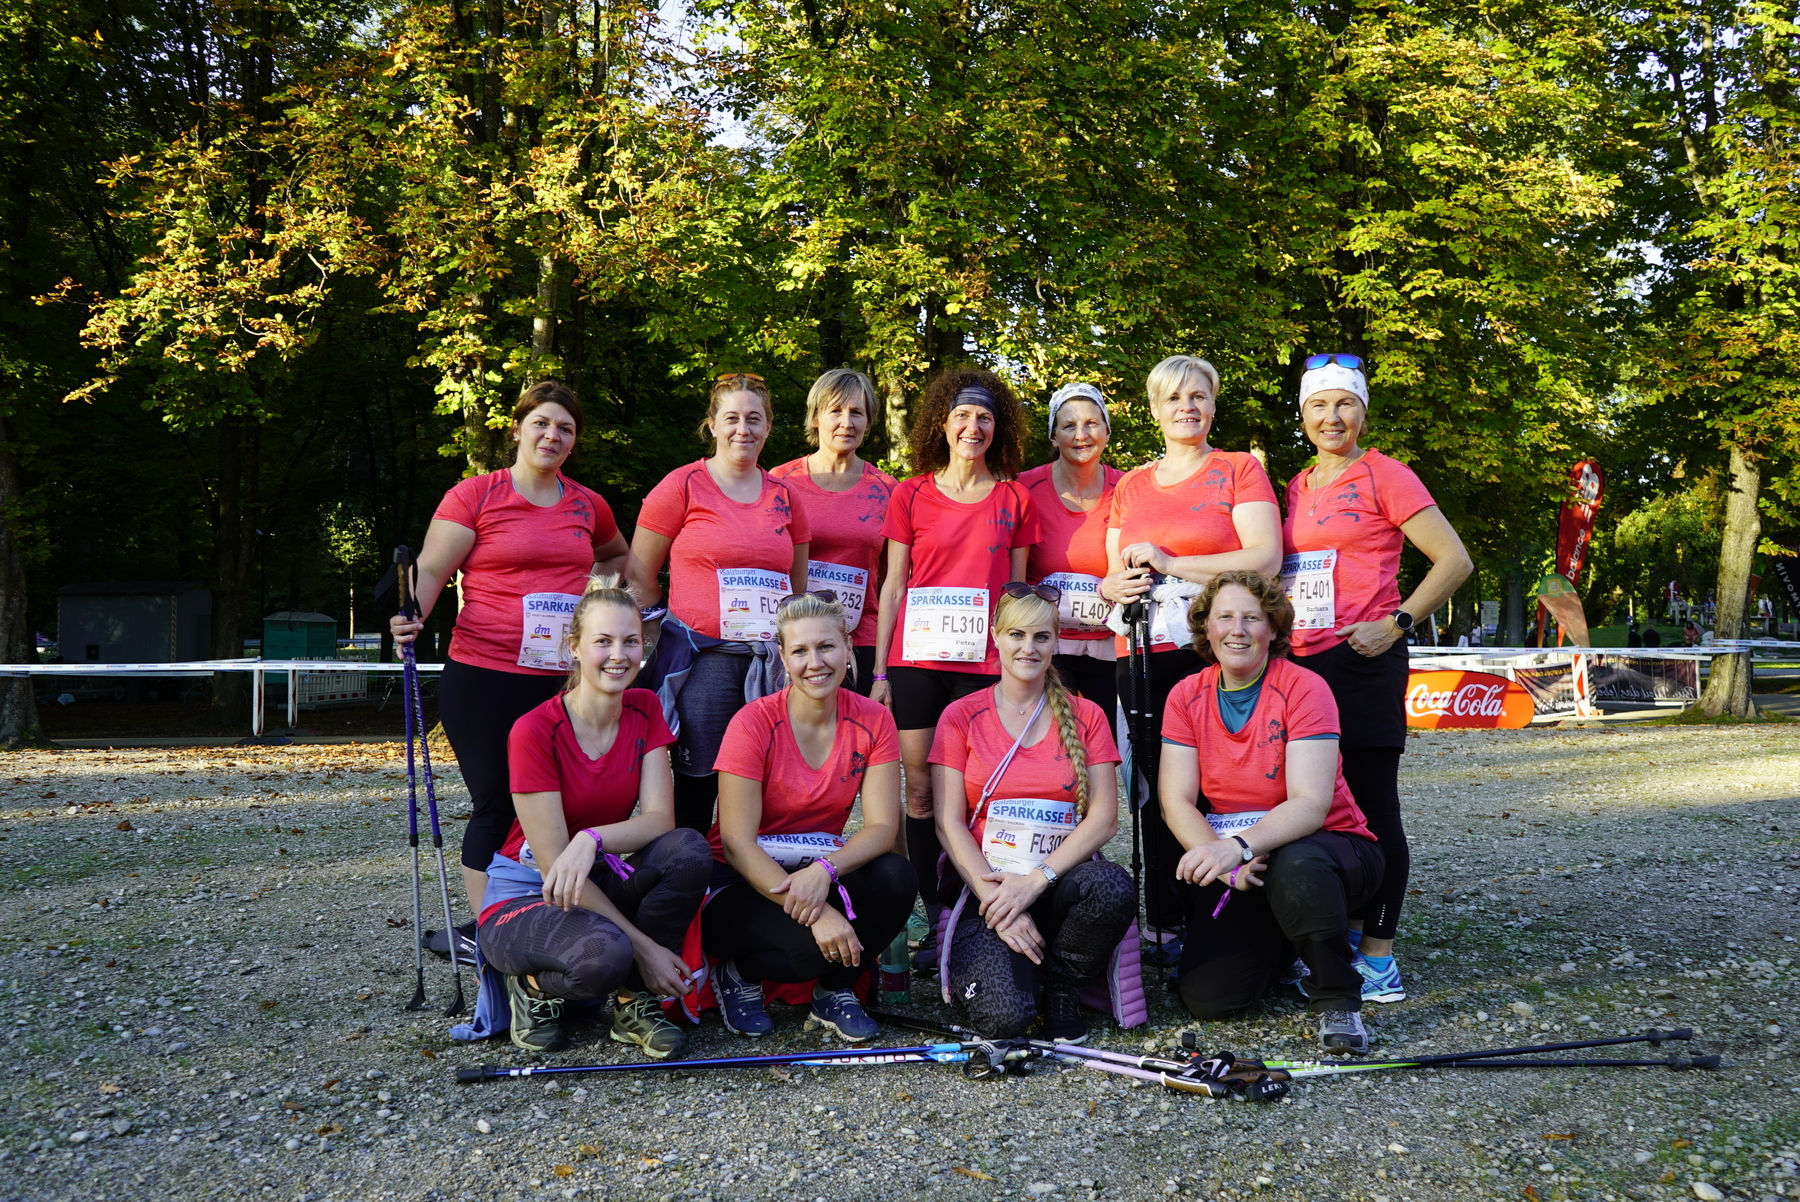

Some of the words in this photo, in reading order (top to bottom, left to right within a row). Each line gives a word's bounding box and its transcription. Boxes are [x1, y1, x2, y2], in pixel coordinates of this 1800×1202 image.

[1566, 528, 1586, 581] balance
[1283, 560, 1322, 574] SPARKASSE
[723, 576, 779, 590] SPARKASSE
[1300, 580, 1330, 600] FL401
[731, 597, 748, 607] dm
[911, 595, 971, 606] SPARKASSE
[1071, 600, 1112, 620] FL402
[534, 624, 550, 635] dm
[913, 618, 930, 627] dm
[942, 615, 984, 635] FL310
[1406, 684, 1505, 717] Coca-Cola
[992, 806, 1064, 824] SPARKASSE
[995, 829, 1016, 842] dm
[1030, 832, 1068, 854] FL30
[1283, 1060, 1321, 1069] LEKI
[1304, 1064, 1339, 1074] LEKI
[1261, 1083, 1283, 1094] LEKI
